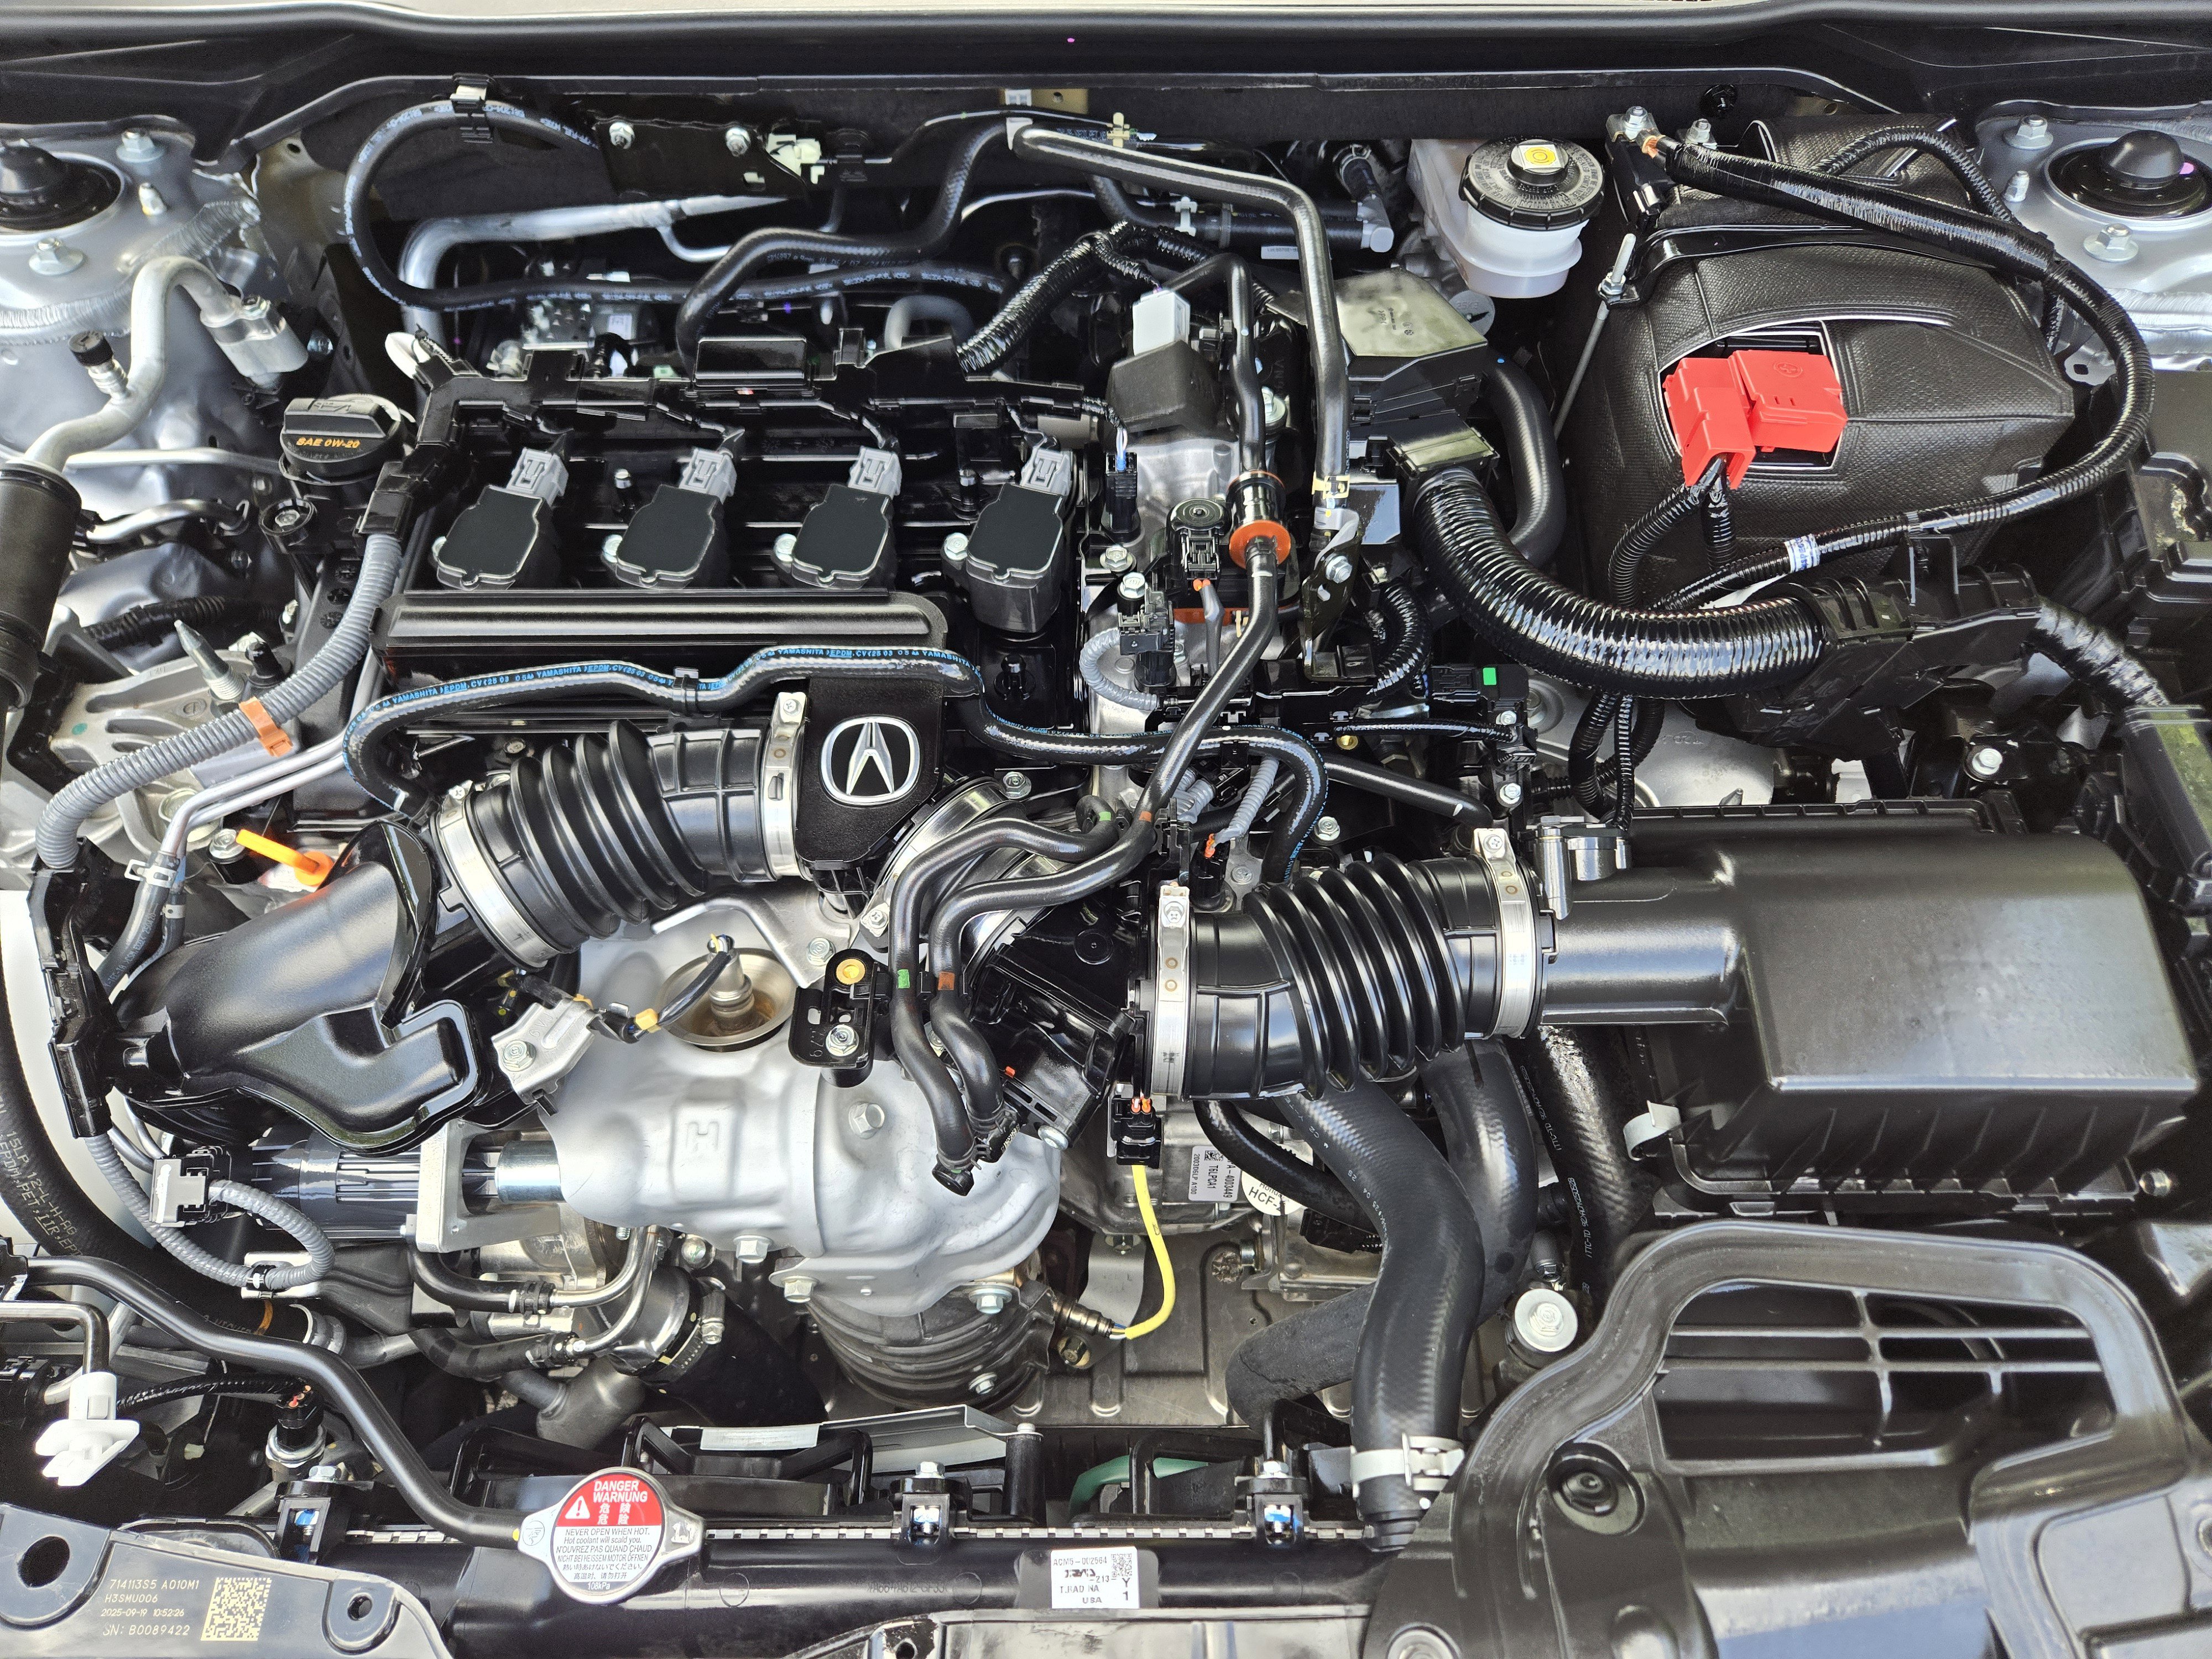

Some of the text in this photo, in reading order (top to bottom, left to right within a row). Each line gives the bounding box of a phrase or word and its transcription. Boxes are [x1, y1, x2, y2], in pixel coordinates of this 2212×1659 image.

[296, 437, 361, 448] SAE 0W-20
[922, 650, 971, 668] YAMASHITA
[392, 688, 438, 704] YAMASHITA
[536, 666, 582, 679] YAMASHITA
[1309, 1125, 1319, 1139] C2
[1192, 1153, 1201, 1181] 2003D6LP
[1207, 1165, 1219, 1188] T6LPCA1
[27, 1171, 77, 1236] 12-L-H-AG
[594, 1480, 640, 1491] DANGER
[593, 1491, 648, 1503] WARNUNG
[628, 1537, 641, 1546] you.
[556, 1545, 588, 1553] N'OUVREZ
[604, 1545, 628, 1553] QUAND
[629, 1545, 653, 1553] CHAUD.
[627, 1552, 649, 1562] ÖFFNEN
[161, 1579, 200, 1590] A010M1
[587, 1582, 611, 1590] 108kPa
[1121, 1577, 1131, 1588] Y
[104, 1593, 158, 1603] H3SMU006
[1123, 1591, 1129, 1601] 1
[101, 1608, 185, 1617] 2025-09-19 10:52:26
[103, 1624, 191, 1636] SN: B0089422
